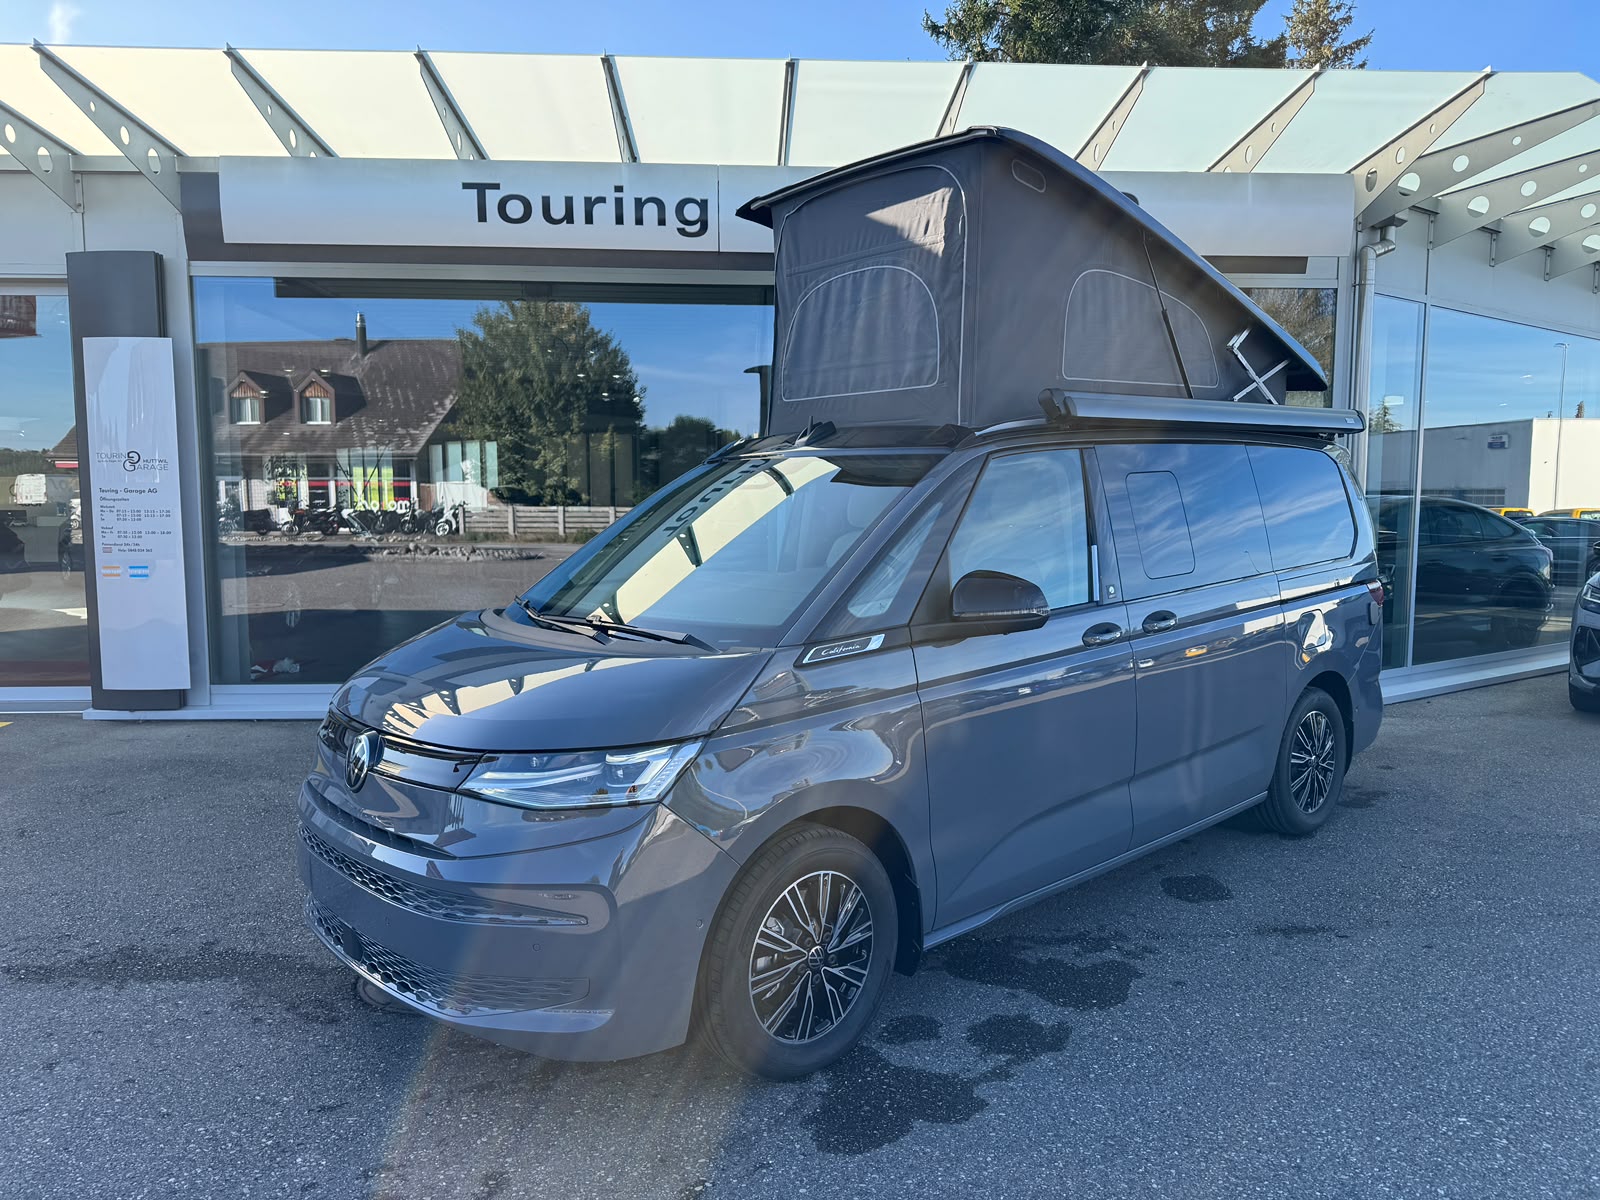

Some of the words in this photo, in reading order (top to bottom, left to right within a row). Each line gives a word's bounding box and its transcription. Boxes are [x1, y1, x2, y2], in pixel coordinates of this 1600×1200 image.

[461, 182, 709, 238] Touring
[99, 487, 119, 495] Touring
[123, 487, 147, 495] Garage
[821, 644, 862, 656] California
